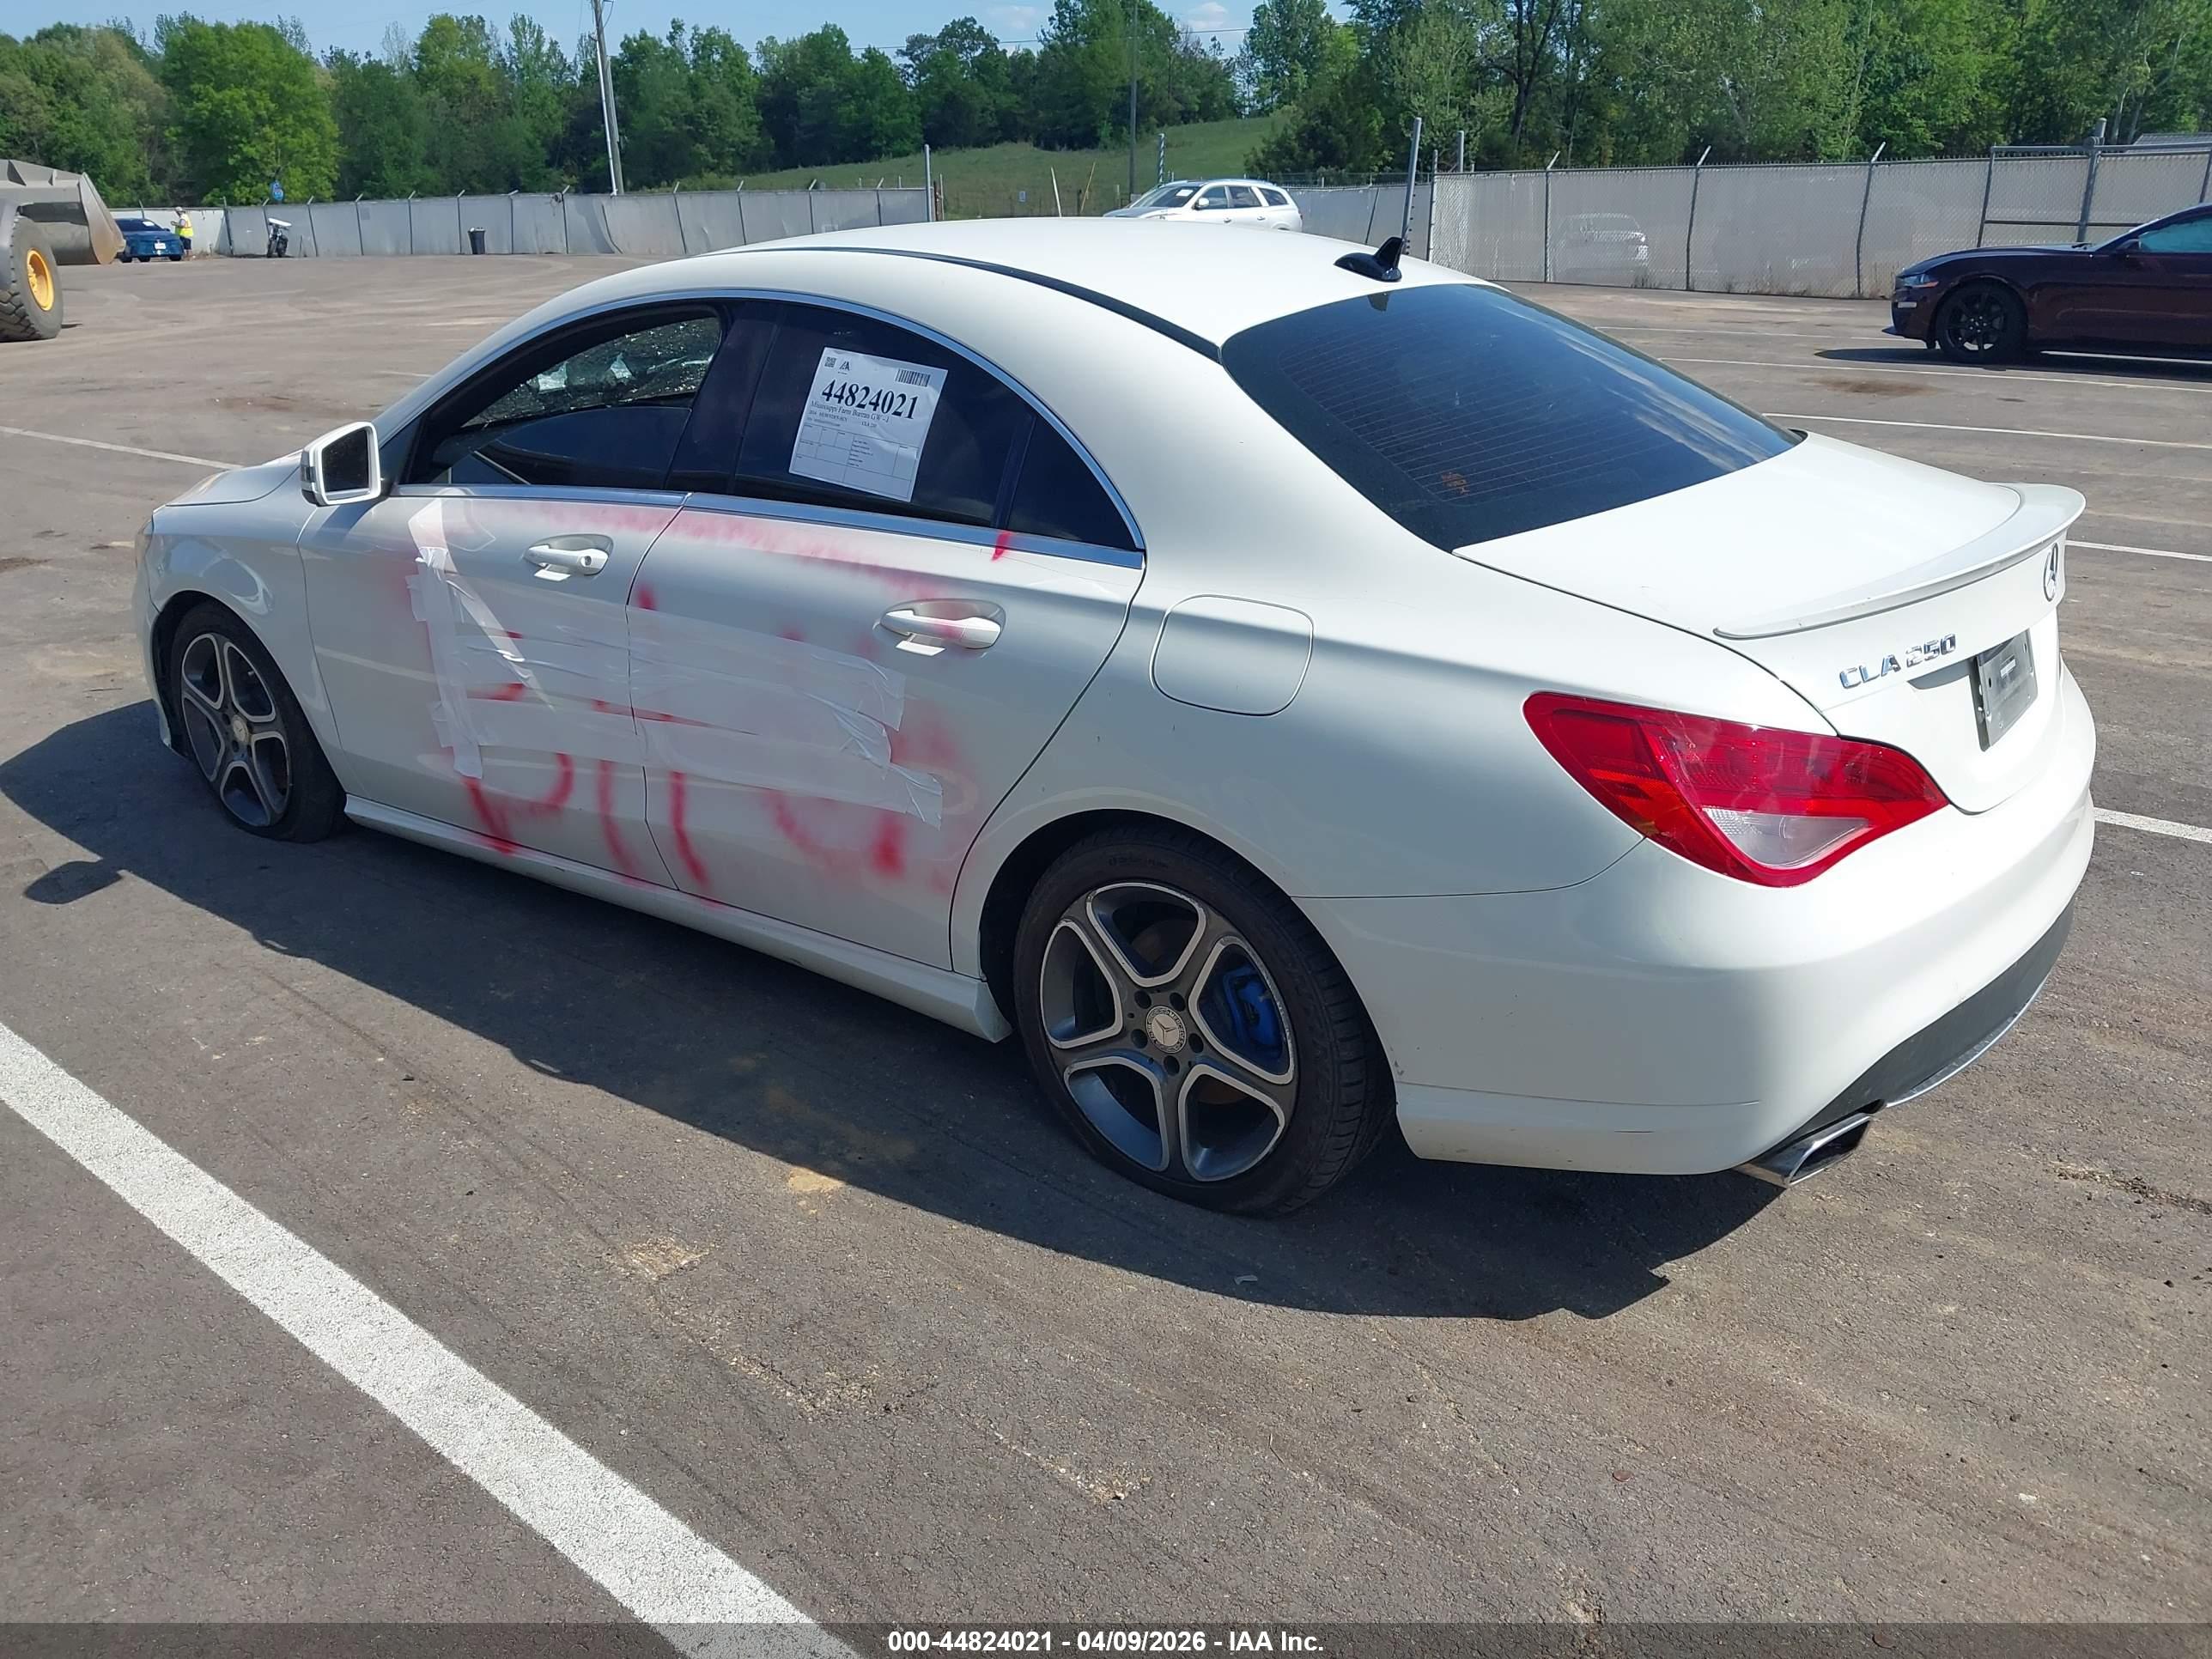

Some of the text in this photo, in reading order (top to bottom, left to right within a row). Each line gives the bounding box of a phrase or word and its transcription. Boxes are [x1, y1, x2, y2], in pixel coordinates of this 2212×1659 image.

[822, 379, 919, 420] 44824021
[1839, 633, 1955, 689] CLA 250
